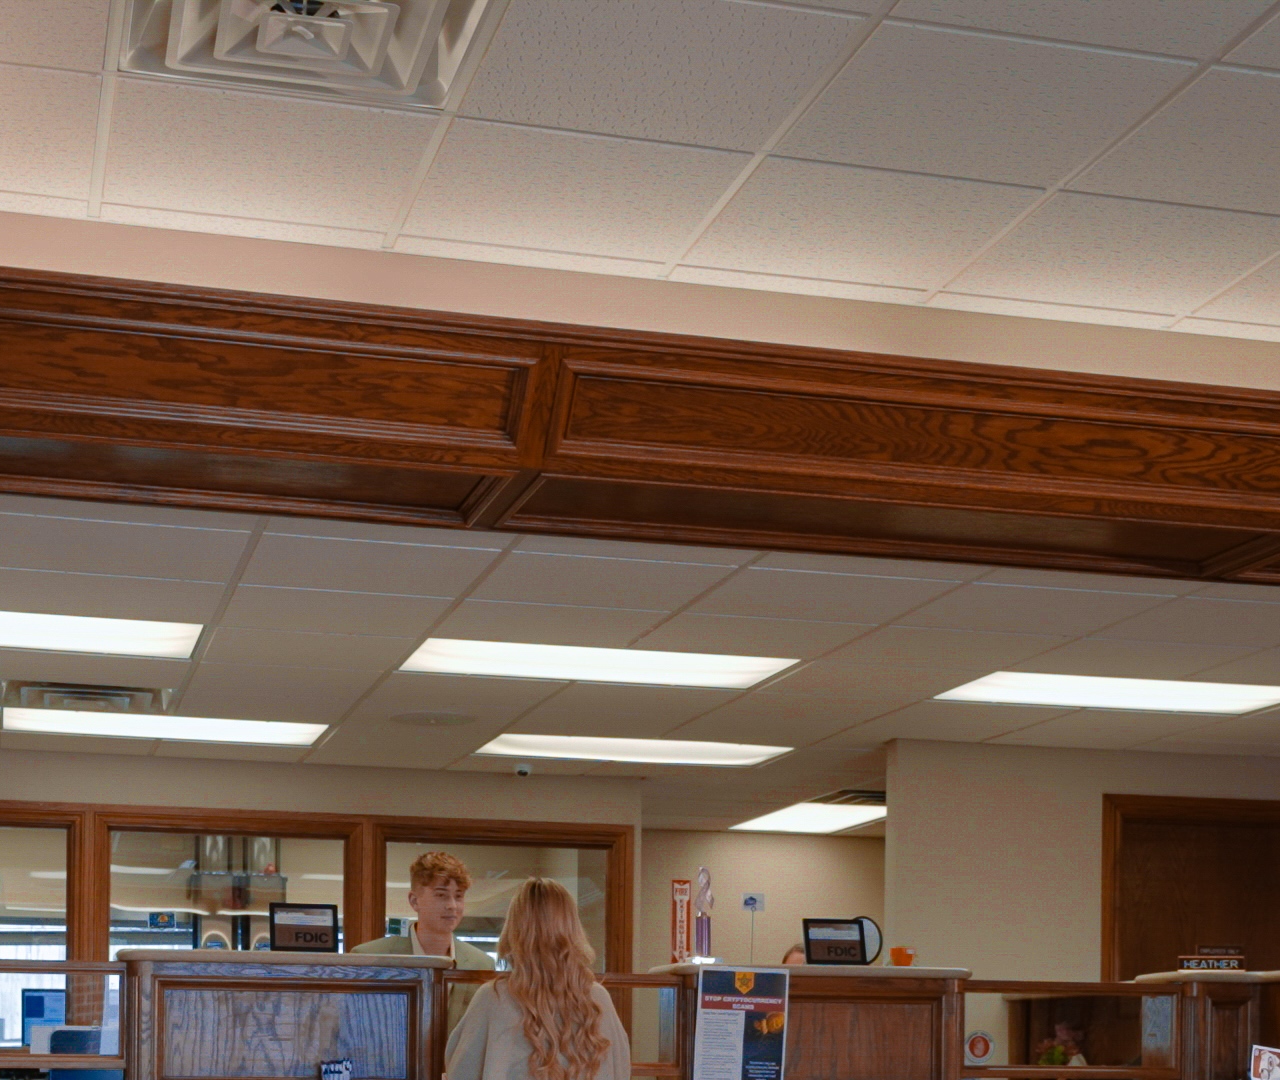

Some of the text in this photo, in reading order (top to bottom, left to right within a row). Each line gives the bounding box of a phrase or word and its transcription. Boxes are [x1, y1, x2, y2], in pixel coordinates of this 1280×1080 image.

[675, 887, 689, 896] FIRE
[294, 931, 330, 944] FDIC
[827, 946, 858, 957] FDIC
[1183, 959, 1239, 969] HEATHER
[723, 996, 782, 1005] CRYPTOCURRENCY
